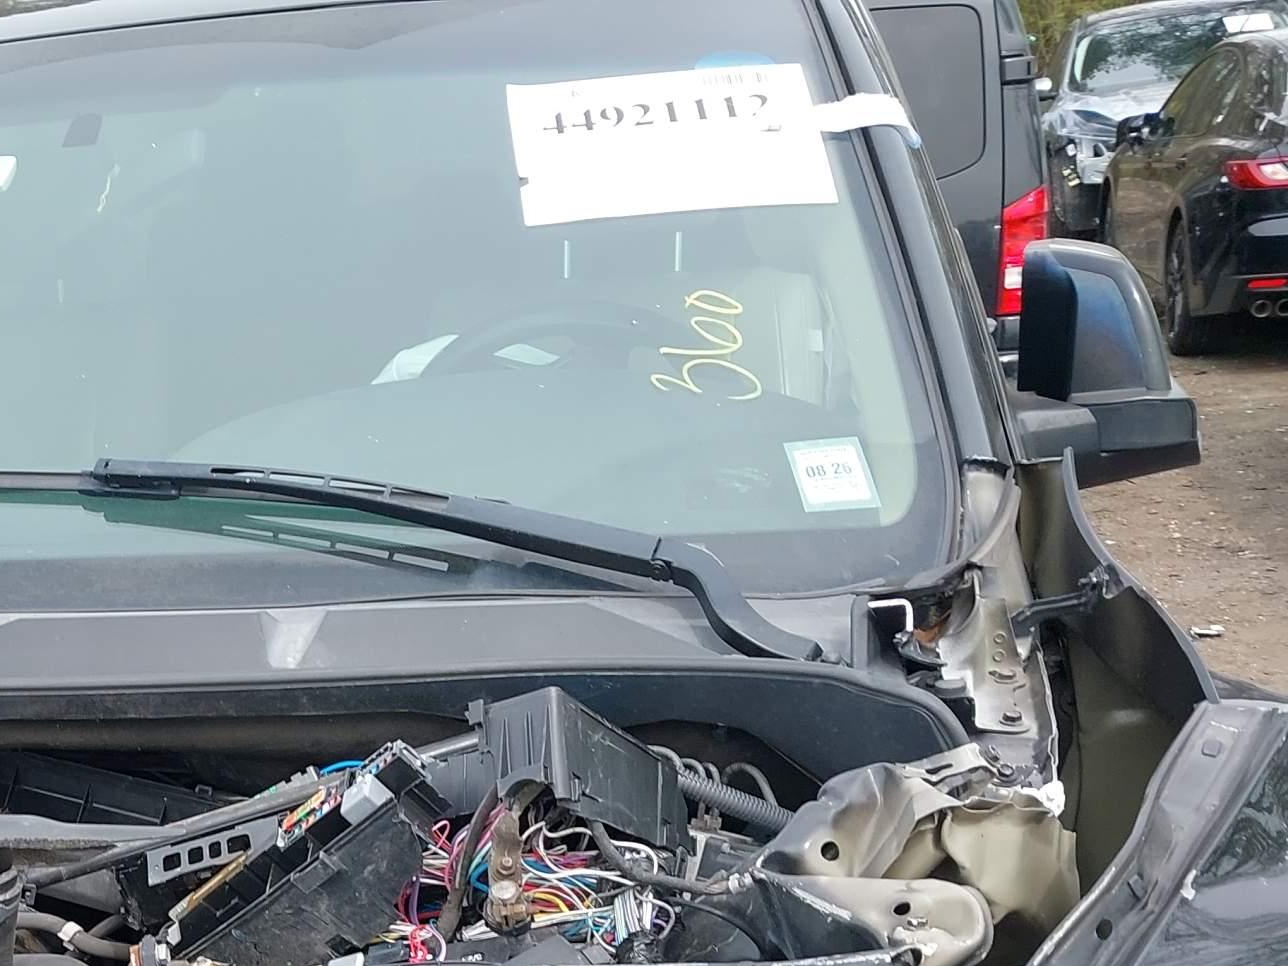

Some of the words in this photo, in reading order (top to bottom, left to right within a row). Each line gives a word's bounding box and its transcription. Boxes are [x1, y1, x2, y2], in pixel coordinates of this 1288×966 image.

[543, 94, 782, 134] 44921112
[650, 289, 762, 400] 360
[805, 465, 827, 478] 08
